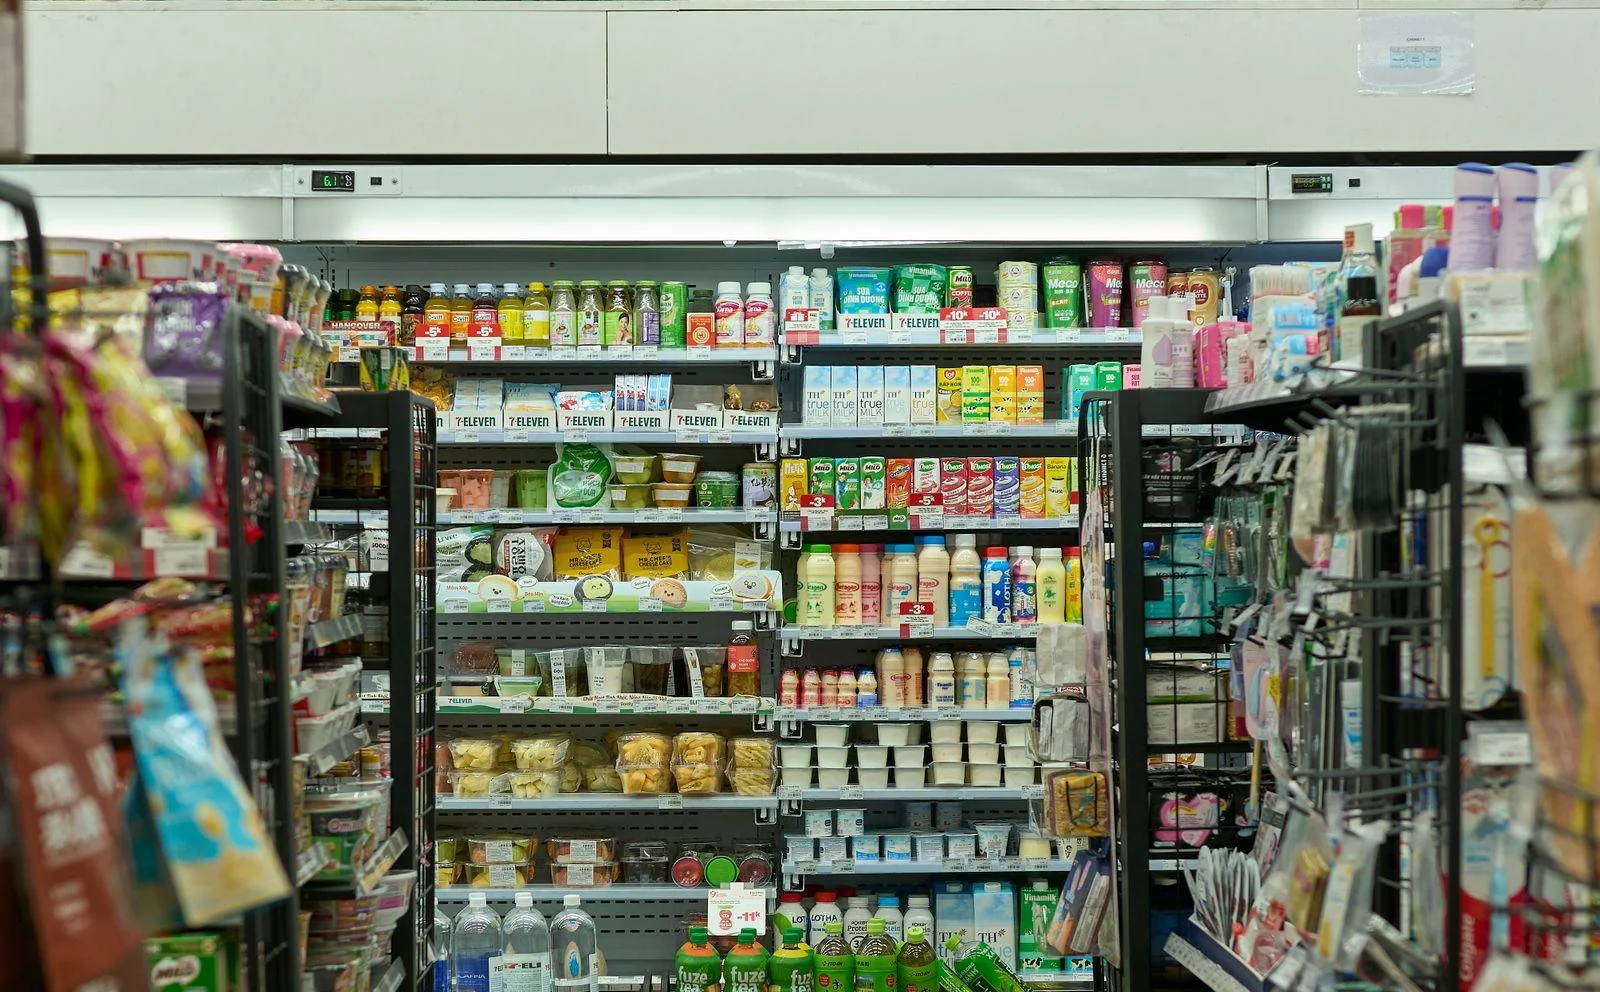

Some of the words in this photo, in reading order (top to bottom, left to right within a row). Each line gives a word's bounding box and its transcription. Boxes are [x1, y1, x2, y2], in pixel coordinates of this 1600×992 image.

[1048, 279, 1078, 288] Meco
[1136, 278, 1166, 289] Meco
[807, 399, 829, 409] true
[832, 399, 855, 409] true
[860, 399, 882, 409] true
[912, 399, 934, 409] true
[807, 409, 829, 417] MILK
[832, 409, 855, 417] MILK
[860, 409, 882, 417] MILK
[1024, 893, 1057, 902] Vinamilk
[978, 932, 998, 942] TH
[1460, 916, 1476, 981] Colgate
[678, 966, 708, 985] fuze
[730, 966, 766, 984] fuze
